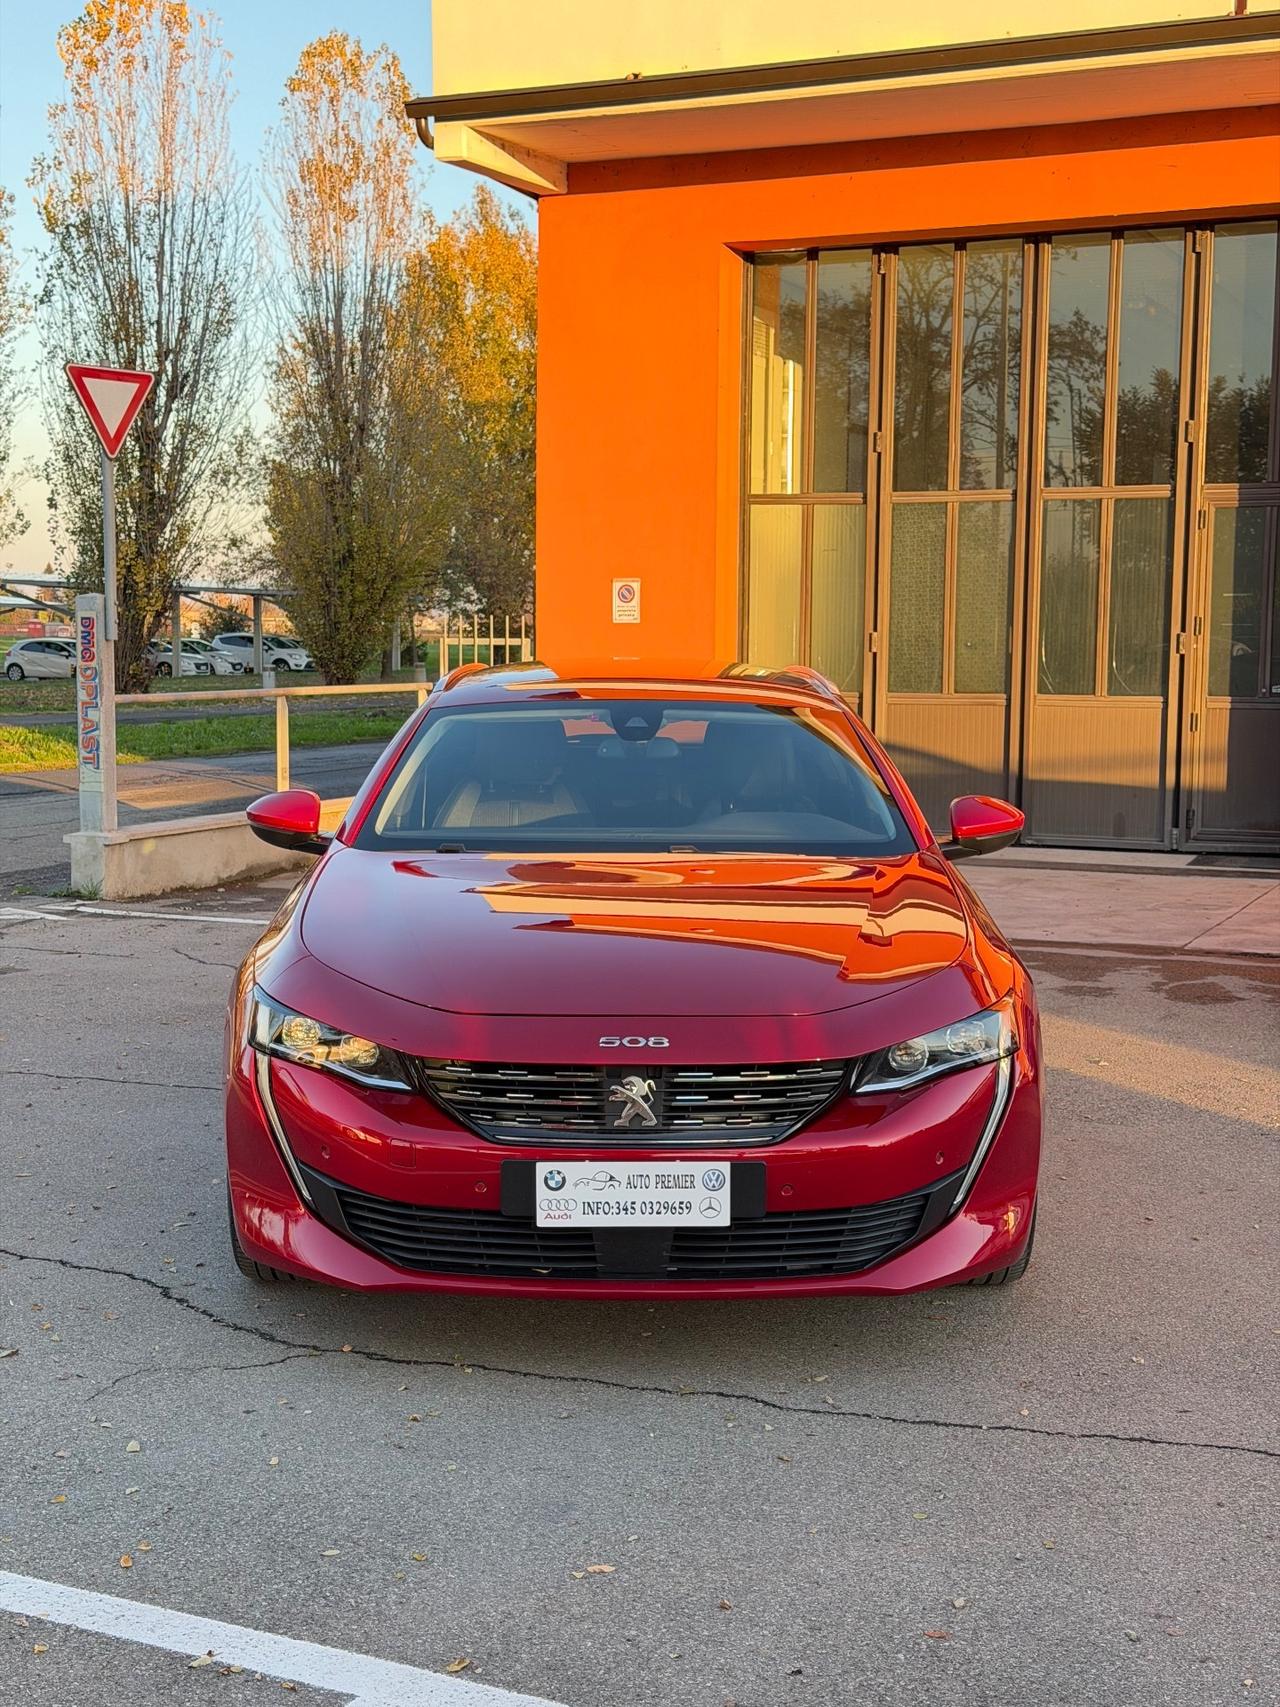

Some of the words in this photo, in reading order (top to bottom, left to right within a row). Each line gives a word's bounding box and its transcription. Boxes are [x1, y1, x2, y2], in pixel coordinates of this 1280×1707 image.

[79, 667, 100, 770] DPLAST
[599, 1036, 670, 1047] 508
[625, 1174, 650, 1189] AUTO
[654, 1174, 696, 1190] PREMIER
[543, 1211, 572, 1220] Audi
[582, 1201, 636, 1216] INFO:345
[640, 1200, 692, 1216] 0329659
